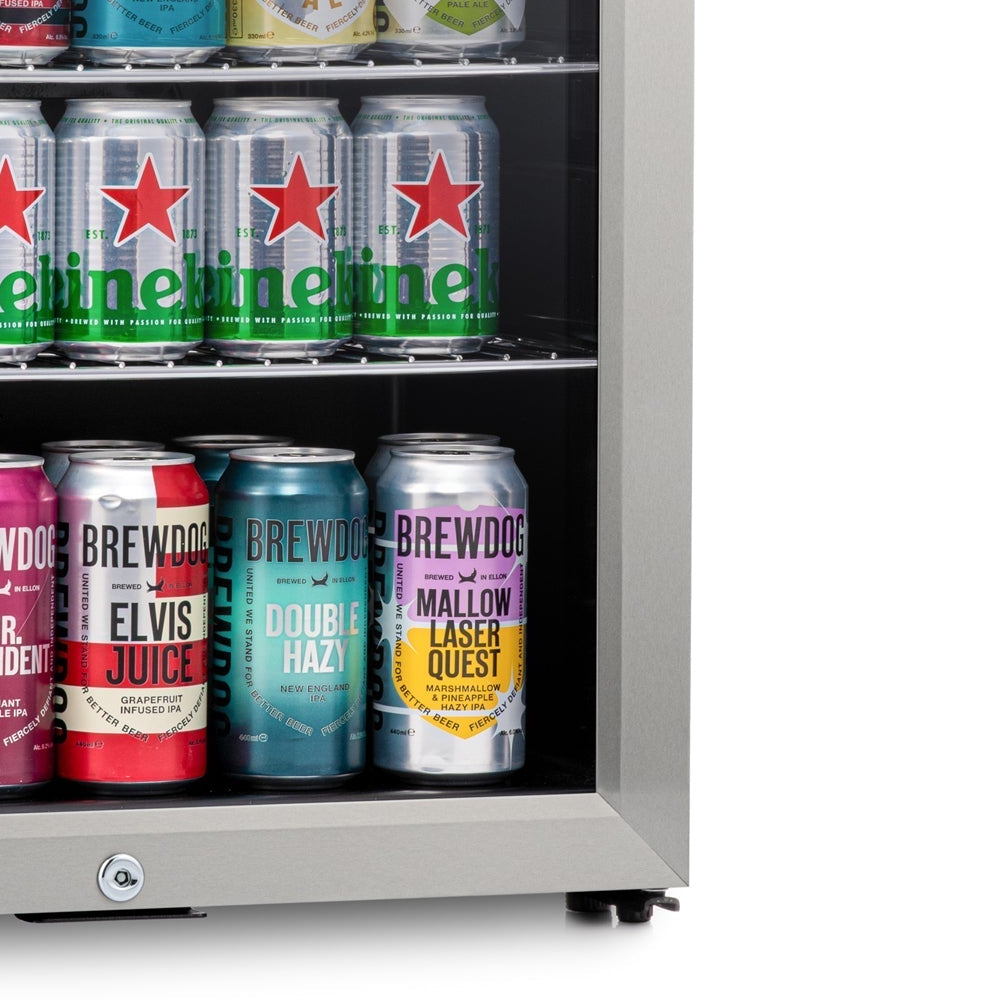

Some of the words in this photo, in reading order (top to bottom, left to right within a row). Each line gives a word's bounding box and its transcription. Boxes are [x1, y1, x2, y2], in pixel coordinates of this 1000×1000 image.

[30, 0, 44, 8] IPA
[160, 4, 175, 12] IPA
[447, 1, 470, 9] PALE
[86, 229, 109, 240] EST.
[237, 227, 260, 238] EST.
[378, 224, 400, 235] EST.
[130, 319, 165, 327] PASSION
[281, 317, 316, 325] PASSION
[397, 513, 525, 559] BREWDOG
[82, 521, 206, 568] BREWDOG
[416, 586, 512, 618] MALLOW
[110, 600, 192, 642] ELVIS
[265, 601, 360, 638] DOUBLE
[430, 619, 501, 649] LASER
[283, 639, 349, 674] HAZY
[106, 643, 193, 685] JUICE
[428, 648, 501, 681] QUEST
[280, 684, 305, 694] NEW
[307, 683, 350, 693] ENGLAND
[426, 683, 501, 692] MARSHMALLOW
[120, 694, 183, 704] GRAPEFRUIT
[310, 695, 326, 703] IPA
[431, 693, 439, 702] &
[441, 693, 494, 702] PINEAPPLE
[120, 705, 165, 715] INFUSED
[167, 704, 182, 714] IPA
[441, 703, 469, 711] HAZY
[470, 703, 486, 711] IPA
[13, 708, 28, 718] IPA
